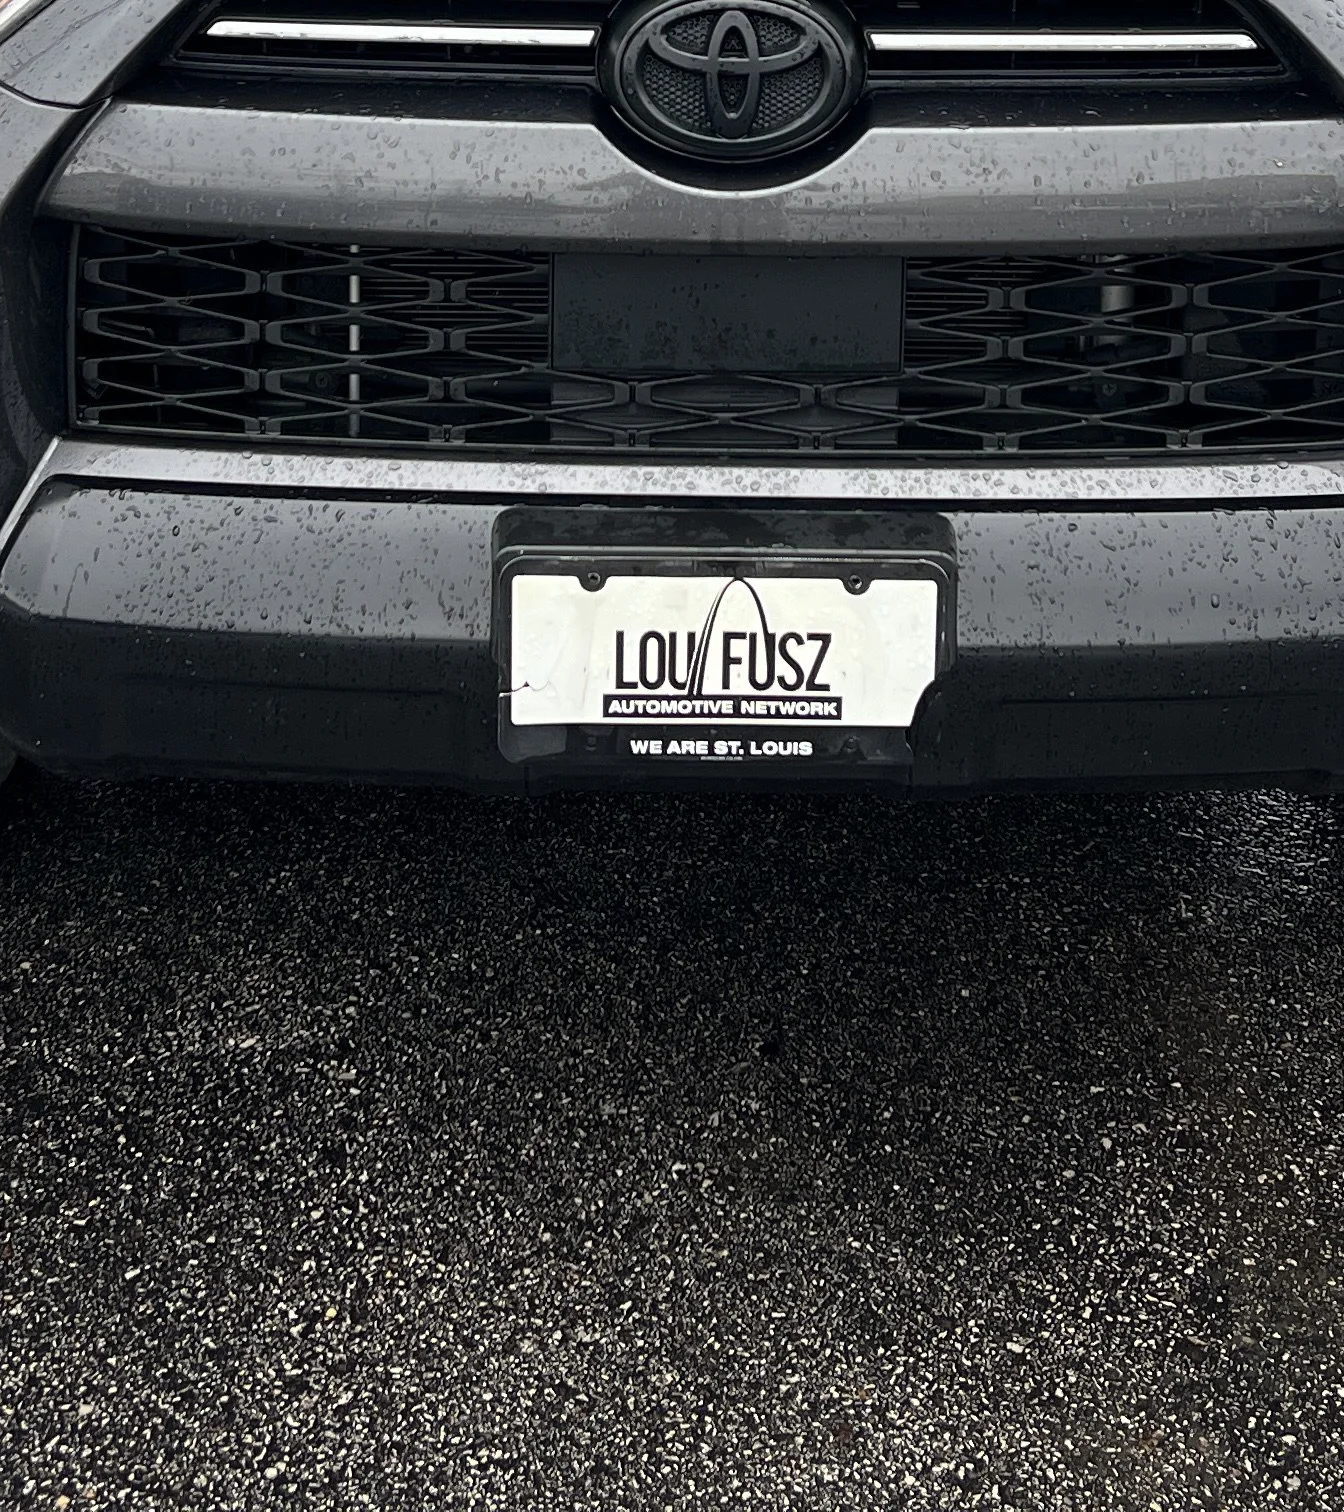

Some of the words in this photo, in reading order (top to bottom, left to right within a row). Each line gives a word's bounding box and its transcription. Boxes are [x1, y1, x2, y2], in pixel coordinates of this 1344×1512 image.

[615, 630, 696, 690] LOU
[722, 631, 833, 692] FUSZ
[608, 699, 734, 715] AUTOMOTIVE
[740, 701, 839, 716] NETWORK
[630, 740, 663, 755] WE
[666, 740, 709, 755] ARE
[713, 740, 745, 755] ST.
[749, 741, 814, 756] LOUIS
